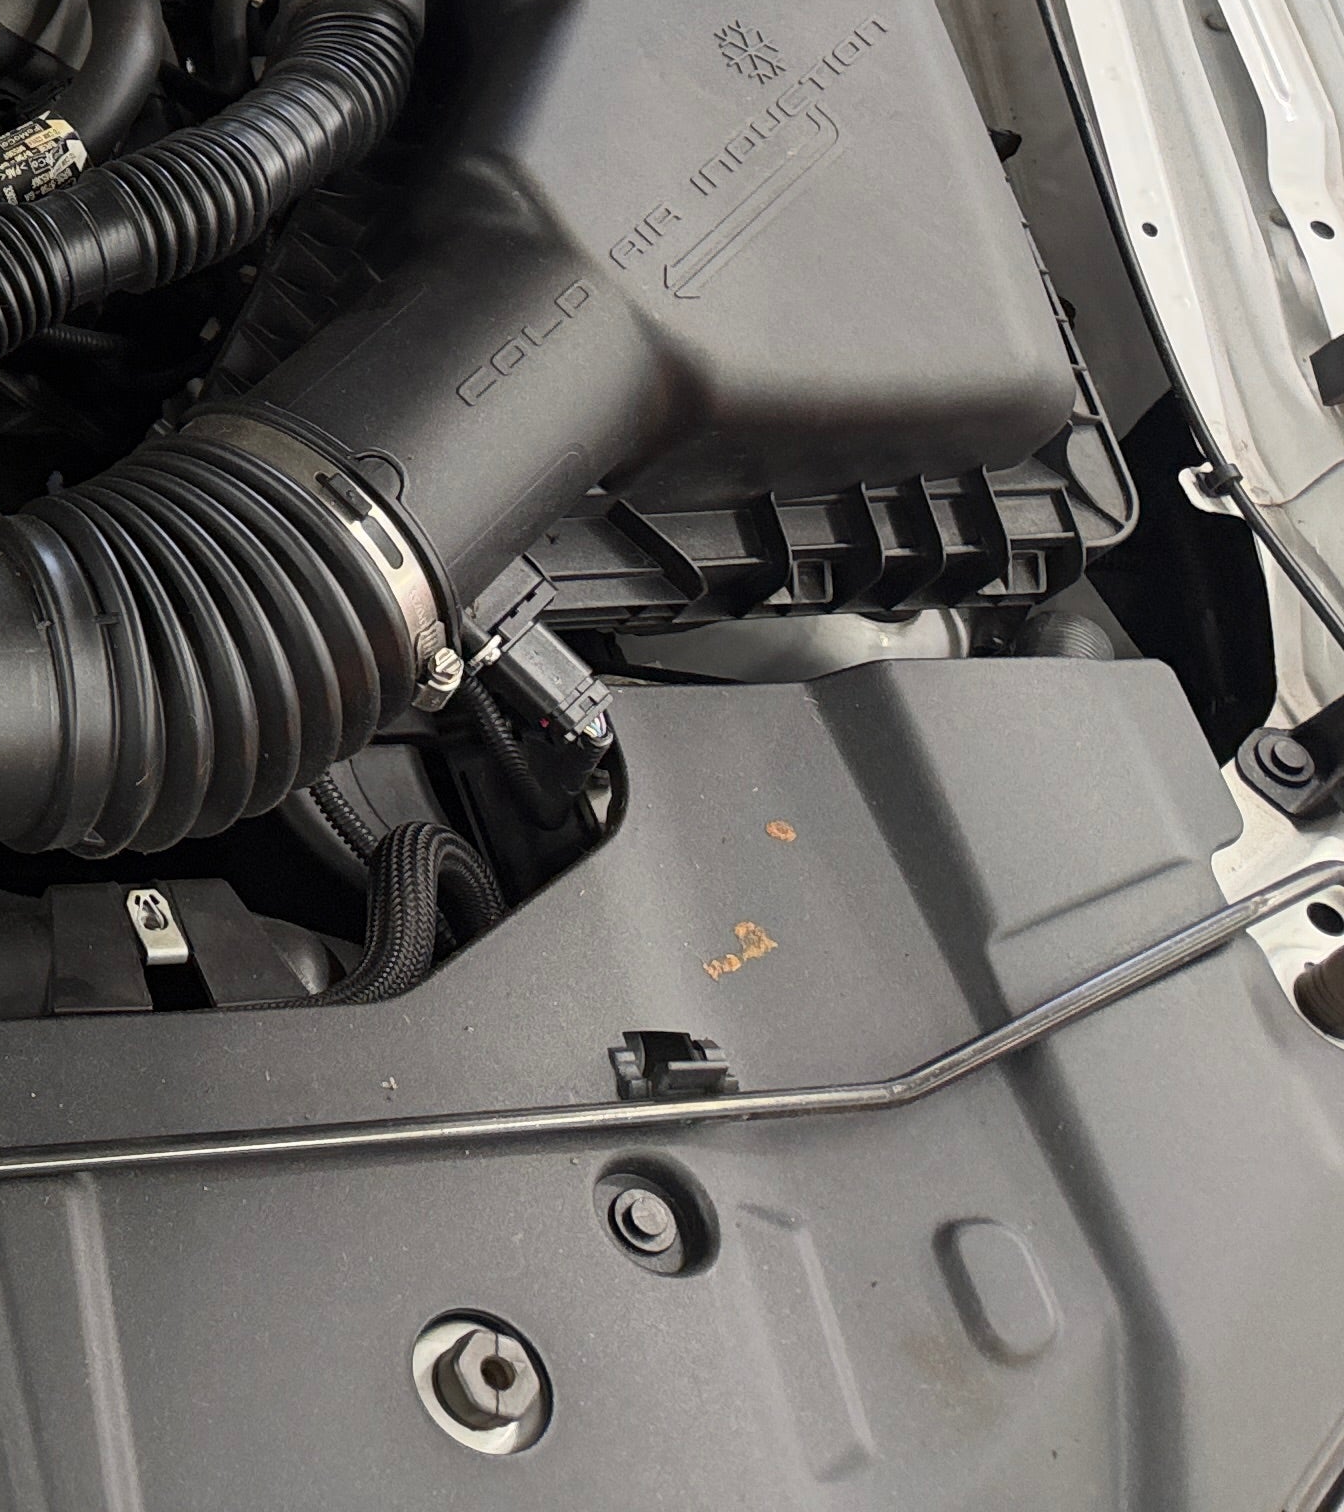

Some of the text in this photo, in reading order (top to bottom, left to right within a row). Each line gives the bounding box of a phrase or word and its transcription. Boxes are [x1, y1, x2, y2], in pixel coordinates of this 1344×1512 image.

[455, 15, 890, 407] COLD AIR INDUCTION
